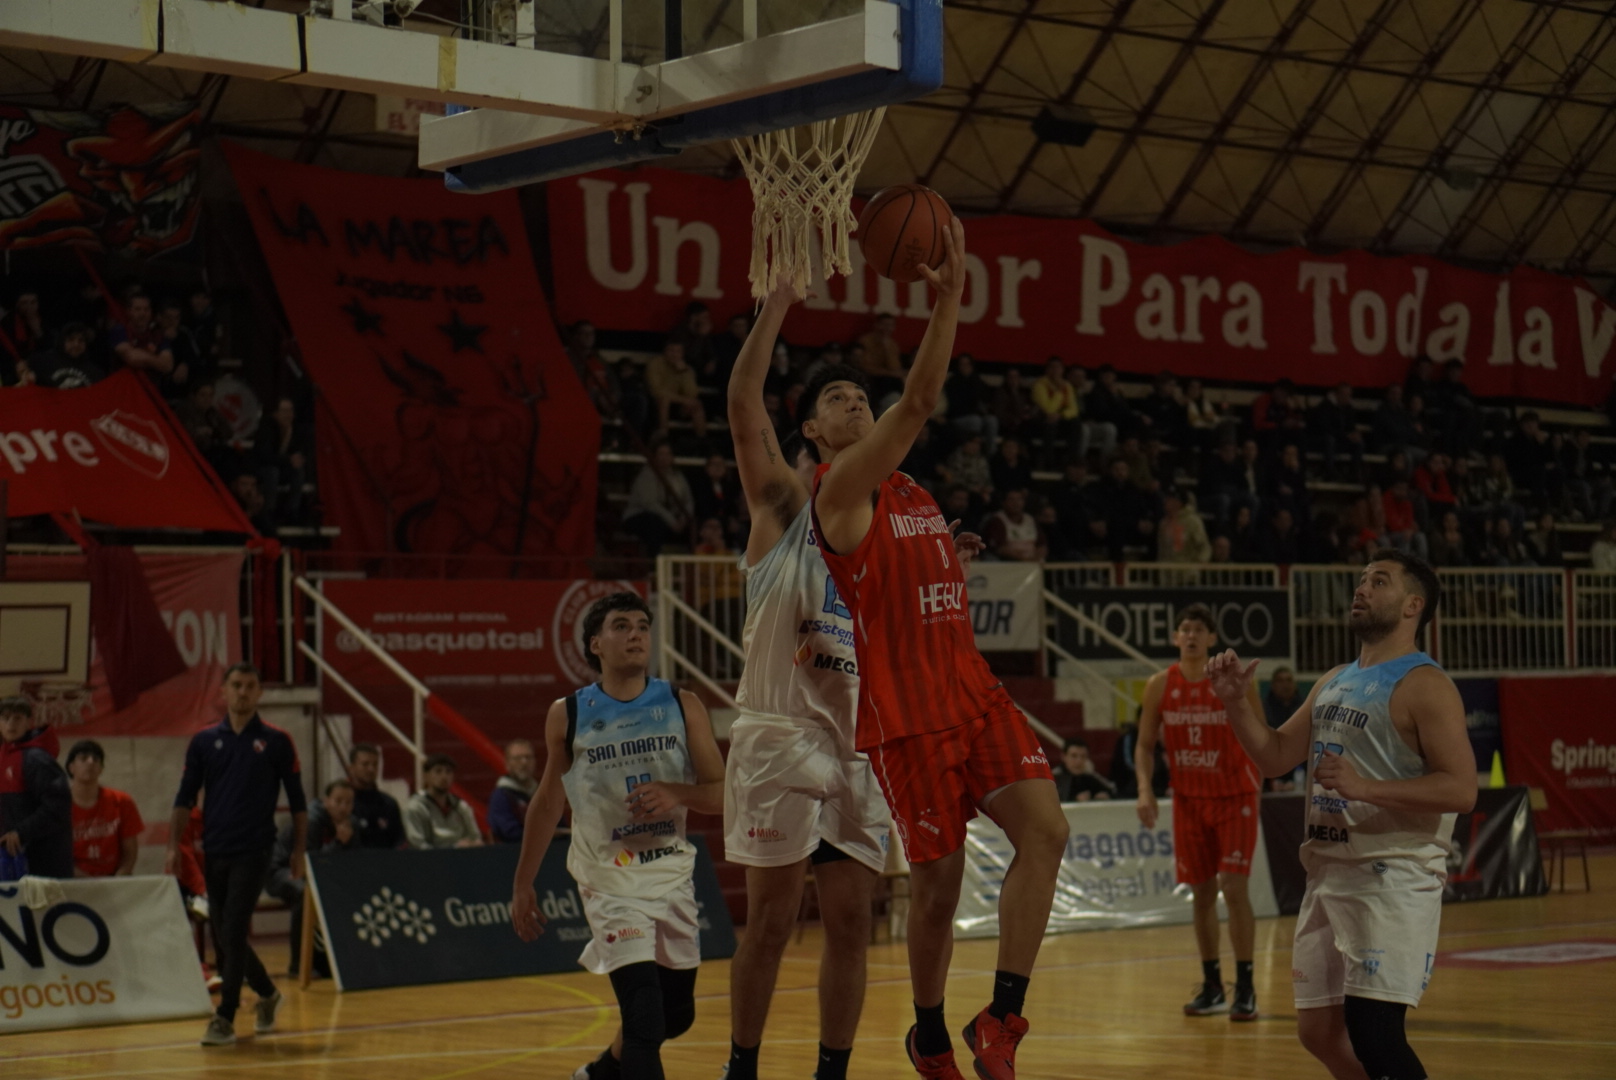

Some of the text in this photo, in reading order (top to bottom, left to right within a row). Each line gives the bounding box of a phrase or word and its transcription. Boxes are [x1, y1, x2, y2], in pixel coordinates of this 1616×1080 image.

[259, 186, 511, 267] LA MAREA
[577, 177, 725, 299] Un
[1075, 233, 1269, 350] Para
[1297, 260, 1472, 365] Toda
[1488, 279, 1558, 371] la
[936, 538, 949, 569] 8
[918, 582, 964, 615] HEGUY
[1077, 602, 1176, 647] HOTEL
[814, 653, 861, 677] MEG
[1324, 705, 1369, 730] MARTIN
[1187, 726, 1203, 745] 12
[587, 736, 677, 764] SAN MARTIN
[1174, 750, 1220, 766] HEGUY
[756, 828, 779, 838] Milo
[444, 895, 513, 928] Gran
[618, 927, 640, 938] Milo
